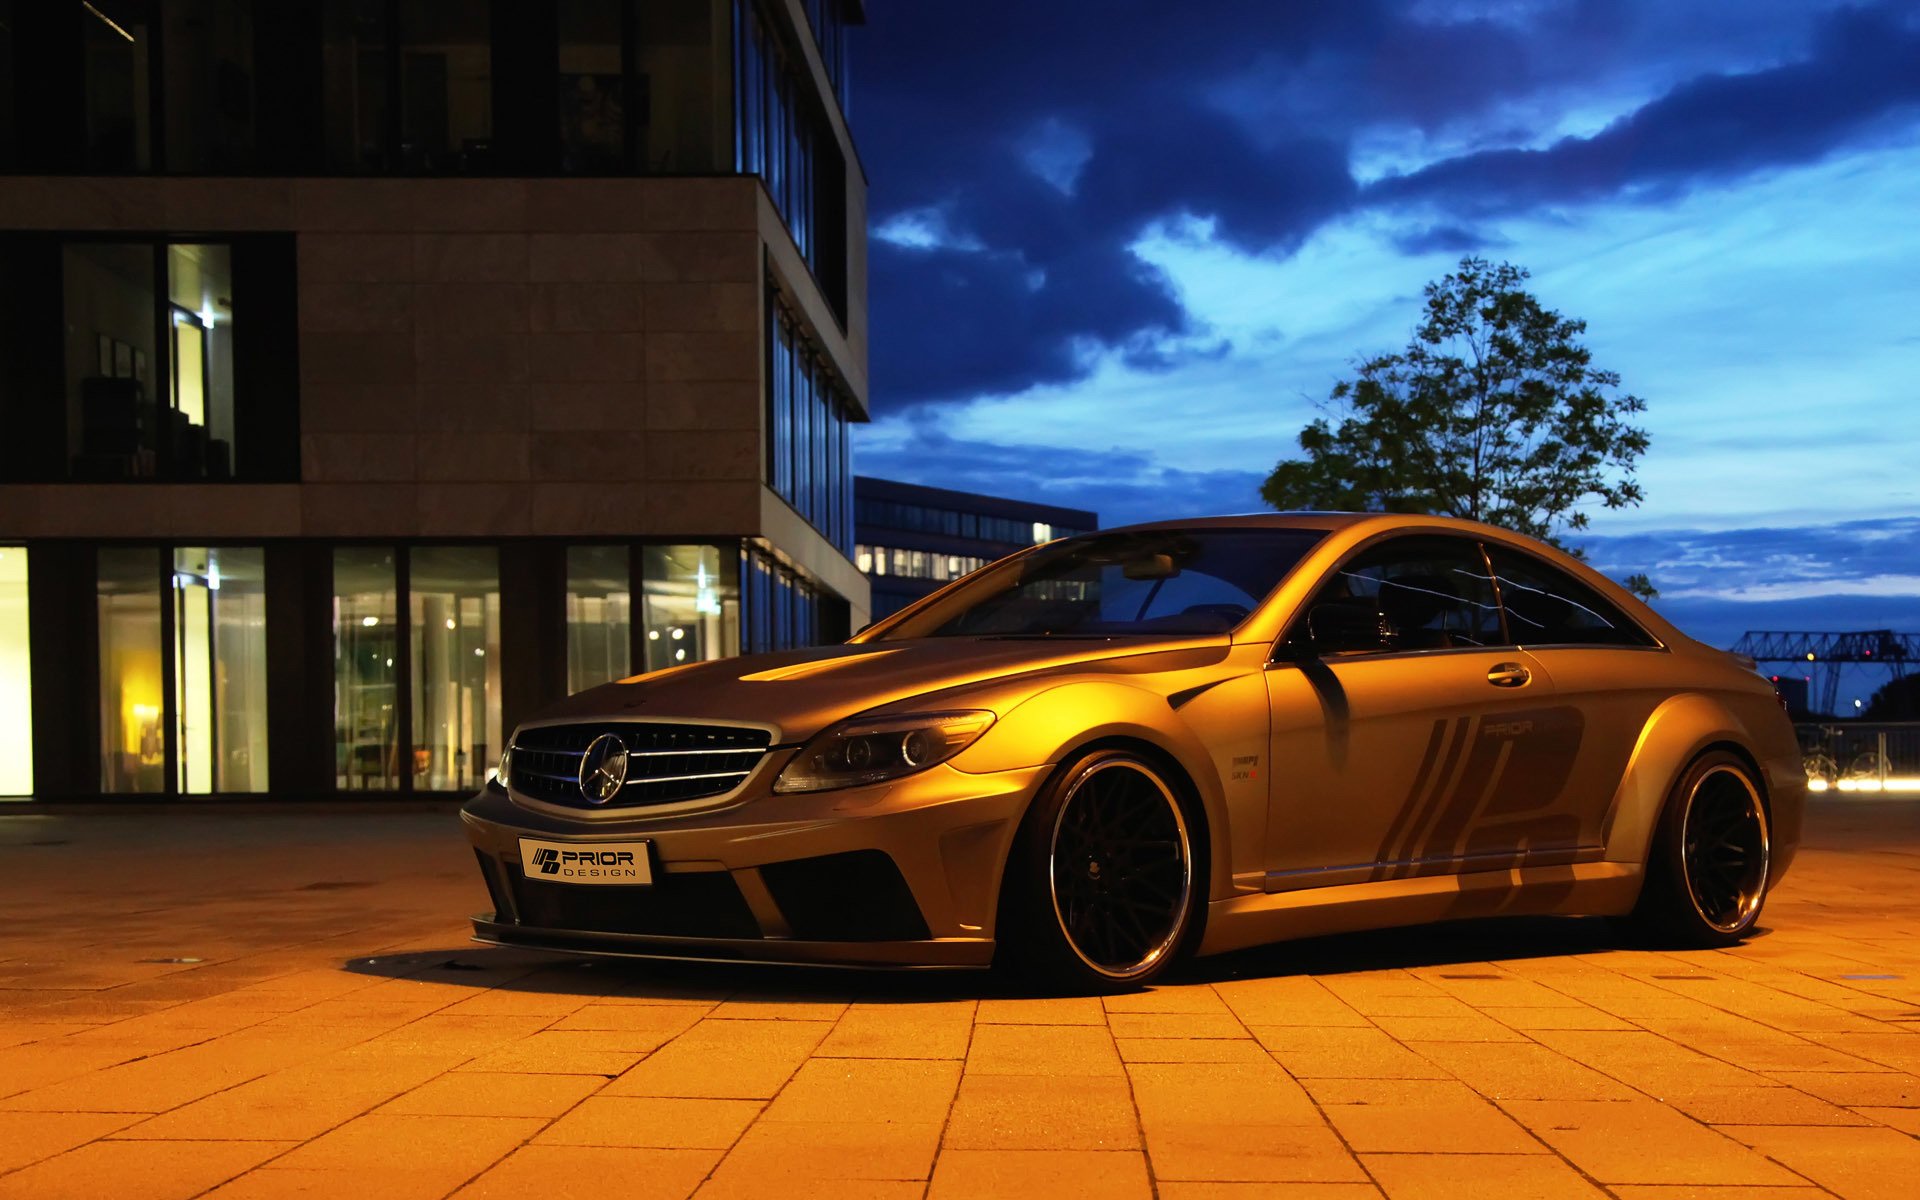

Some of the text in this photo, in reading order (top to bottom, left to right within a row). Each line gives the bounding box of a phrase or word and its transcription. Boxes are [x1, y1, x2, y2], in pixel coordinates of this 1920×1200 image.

[1485, 721, 1534, 737] PRIOR
[562, 851, 634, 866] PRIOR
[563, 868, 636, 877] DESIGN
